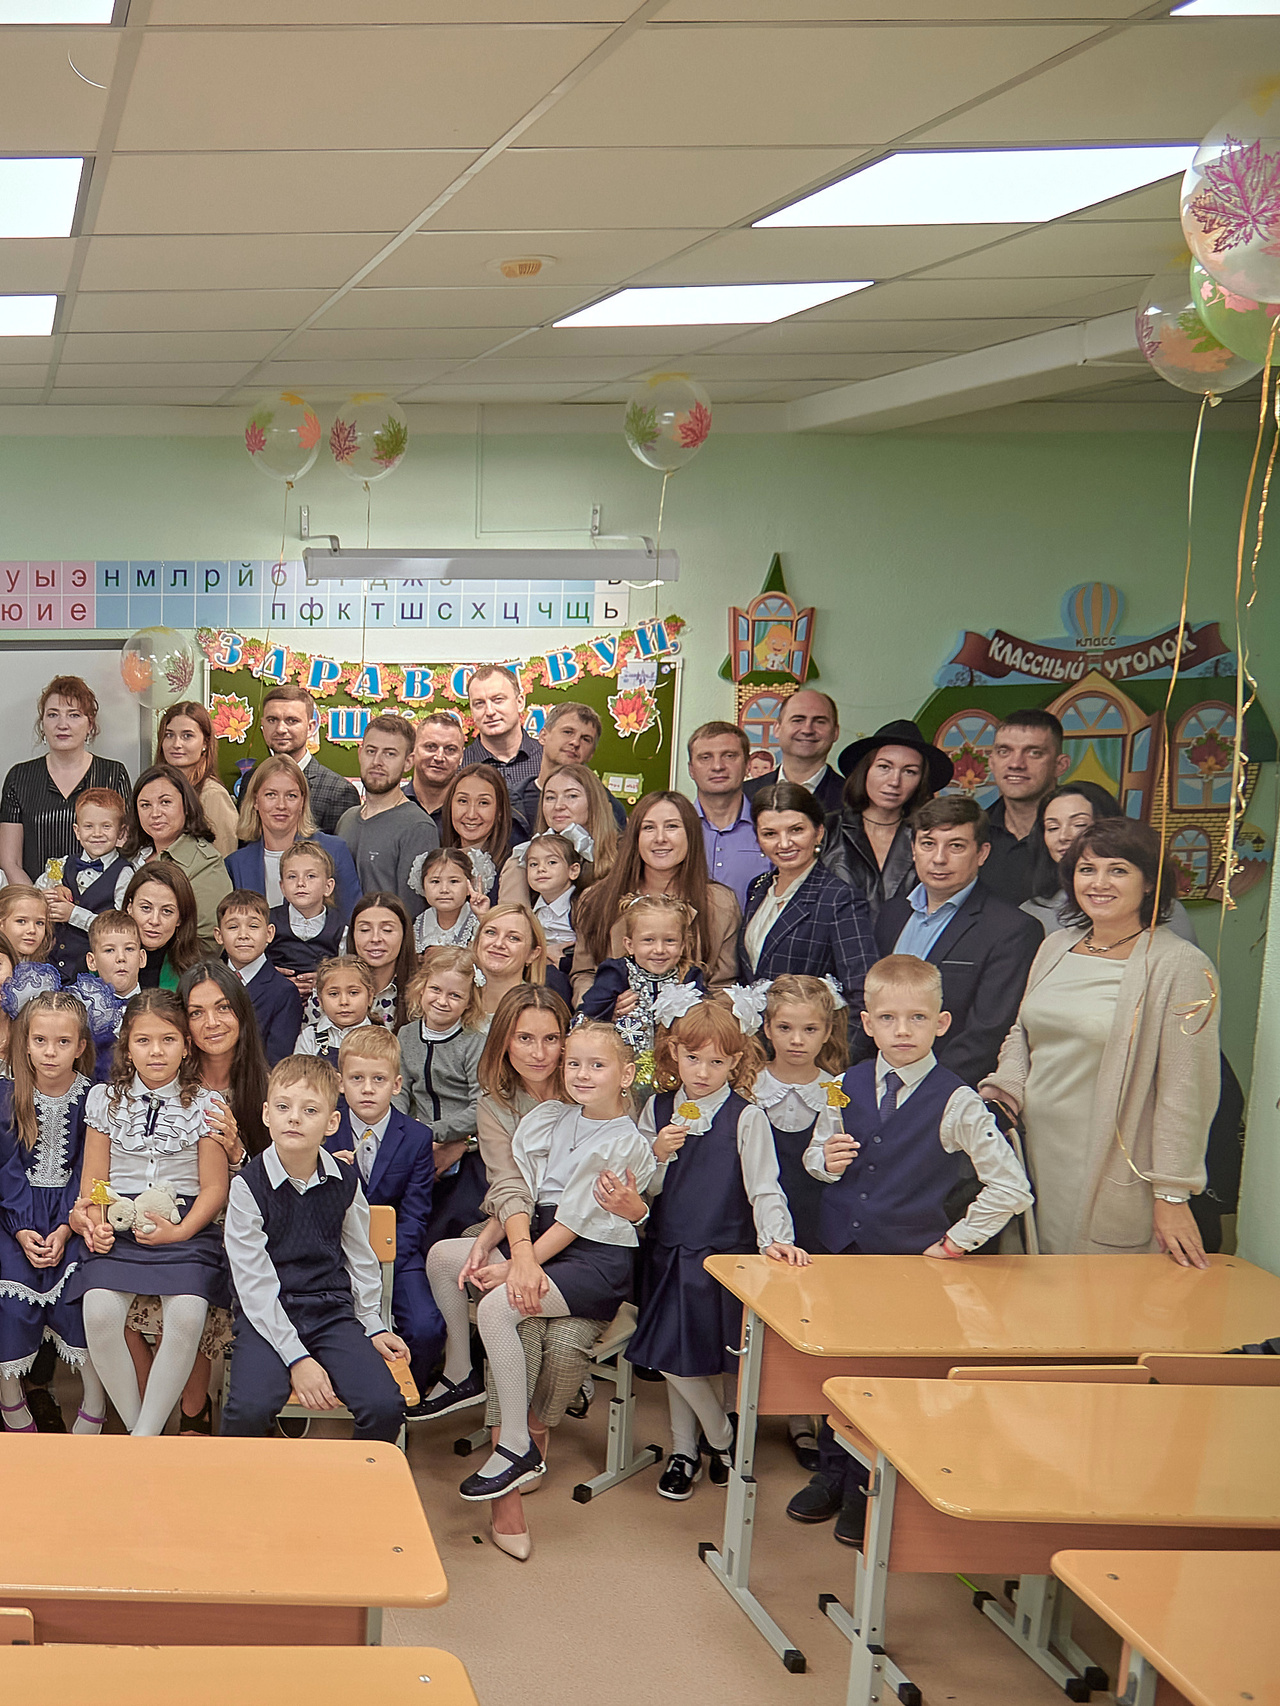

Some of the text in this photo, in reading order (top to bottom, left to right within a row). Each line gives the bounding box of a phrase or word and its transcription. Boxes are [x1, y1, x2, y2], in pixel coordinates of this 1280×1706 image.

[6, 571, 21, 592] у
[35, 571, 56, 588] ы
[72, 570, 87, 588] э
[105, 571, 120, 587] н
[137, 571, 156, 587] м
[170, 571, 188, 587] л
[205, 570, 220, 592] р
[239, 563, 253, 587] й
[1, 604, 21, 621] ю
[38, 604, 52, 621] и
[70, 603, 87, 621] е
[272, 603, 286, 620] п
[299, 597, 324, 626] ф
[338, 603, 351, 620] к
[371, 603, 385, 620] т
[401, 603, 423, 620] ш
[437, 602, 453, 620] с
[471, 603, 486, 619] х
[503, 603, 520, 624] ц
[538, 603, 552, 619] ч
[567, 602, 590, 623] щ
[604, 602, 619, 619] ь
[988, 631, 1197, 680] КЛАССНЫЙ УГОЛОК
[1076, 637, 1116, 647] класс
